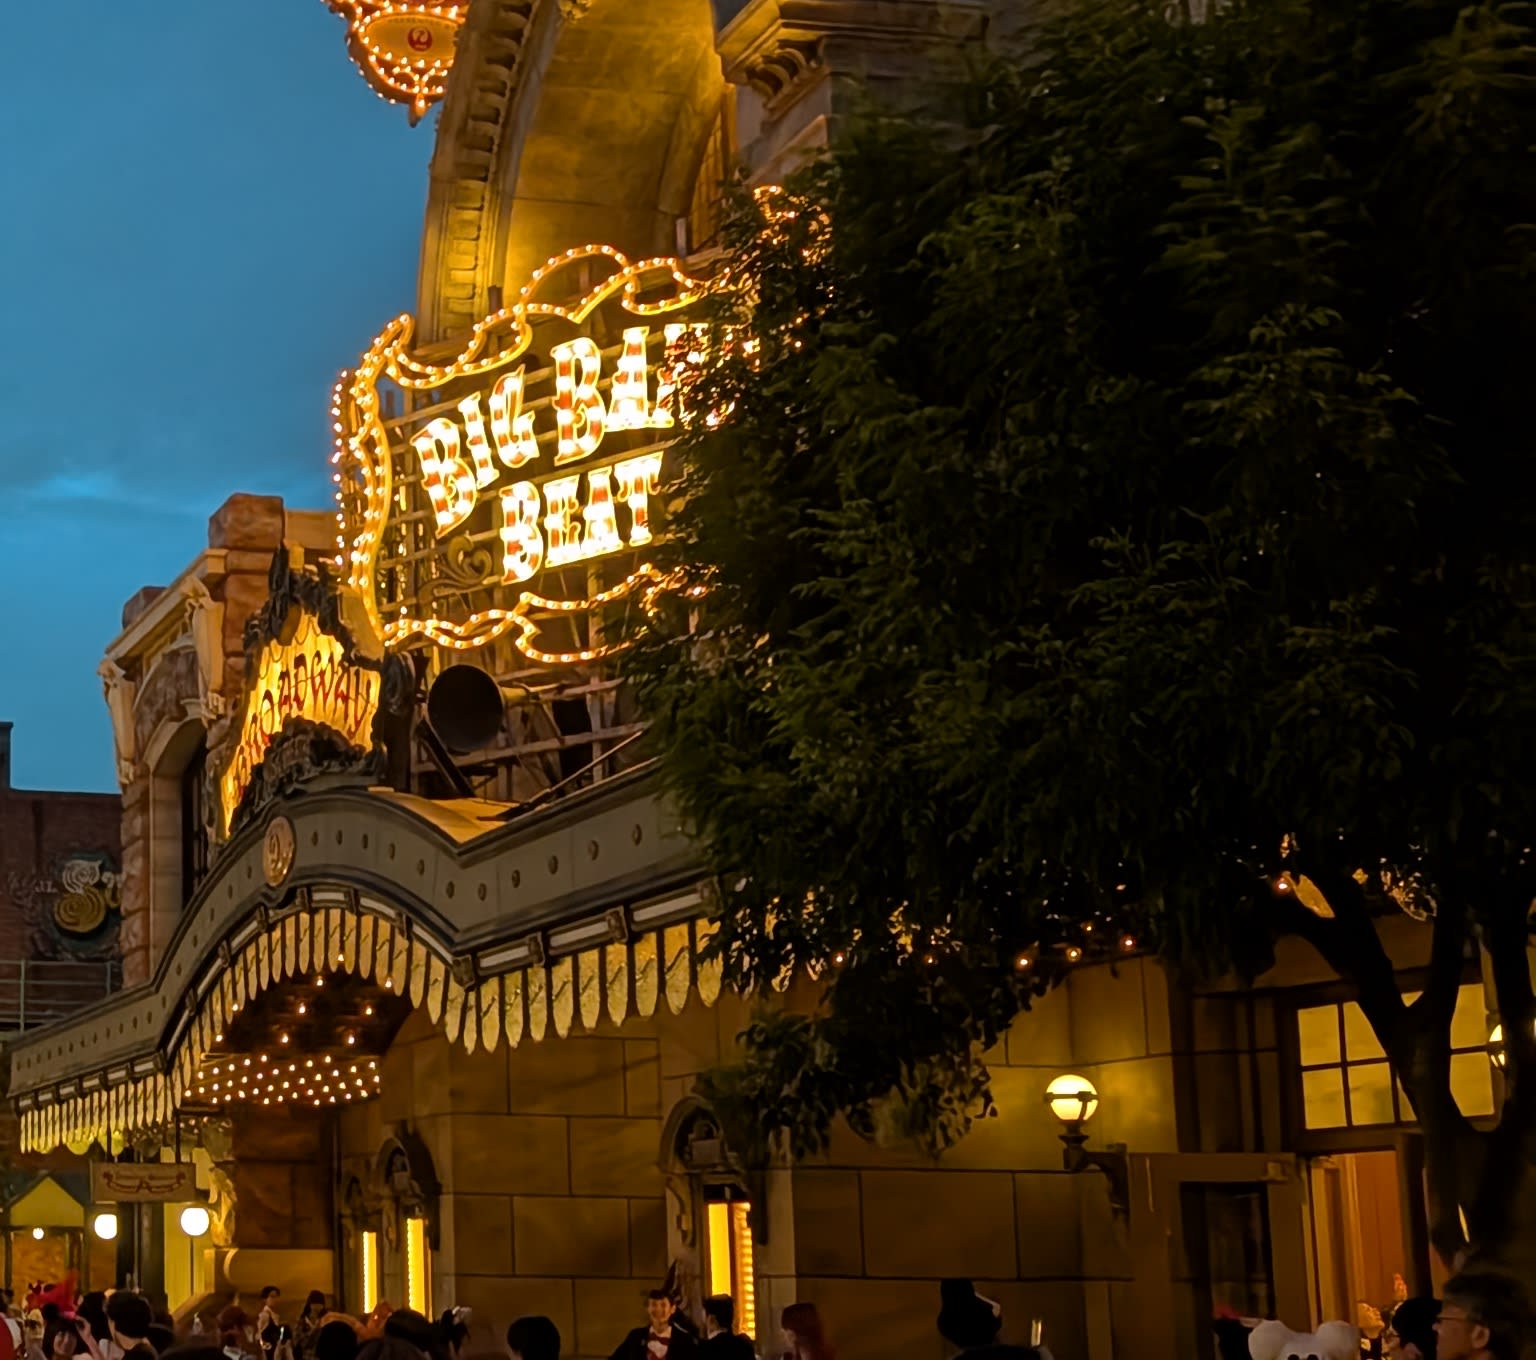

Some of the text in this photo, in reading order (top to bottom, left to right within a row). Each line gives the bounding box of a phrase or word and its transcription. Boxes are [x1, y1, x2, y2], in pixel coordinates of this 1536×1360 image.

[410, 324, 760, 539] BIG BAN
[499, 451, 663, 585] BEAT
